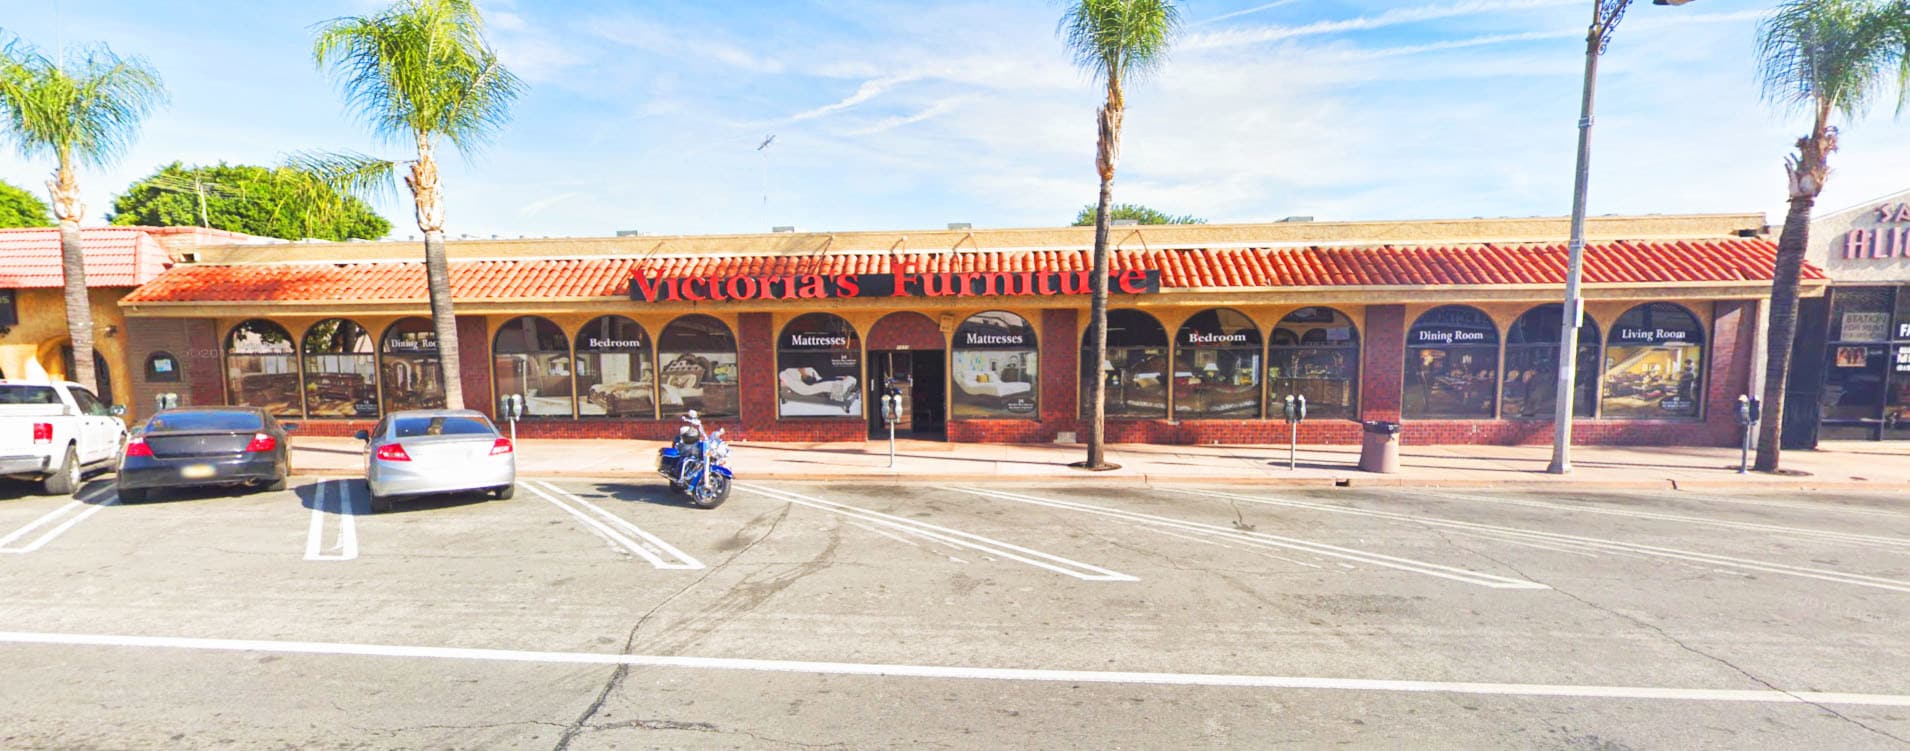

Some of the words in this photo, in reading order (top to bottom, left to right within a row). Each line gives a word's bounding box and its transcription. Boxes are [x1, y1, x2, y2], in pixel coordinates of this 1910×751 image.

[631, 269, 859, 302] Victoria's
[791, 335, 847, 346] Mattresses
[966, 333, 1024, 344] Mattresses
[1188, 333, 1247, 343] Bedroom
[1419, 331, 1453, 343] Dining
[1455, 331, 1484, 340] Room
[1622, 329, 1654, 341] Living
[1656, 329, 1686, 339] Room
[391, 339, 418, 350] Dining
[589, 338, 640, 347] Bedroom
